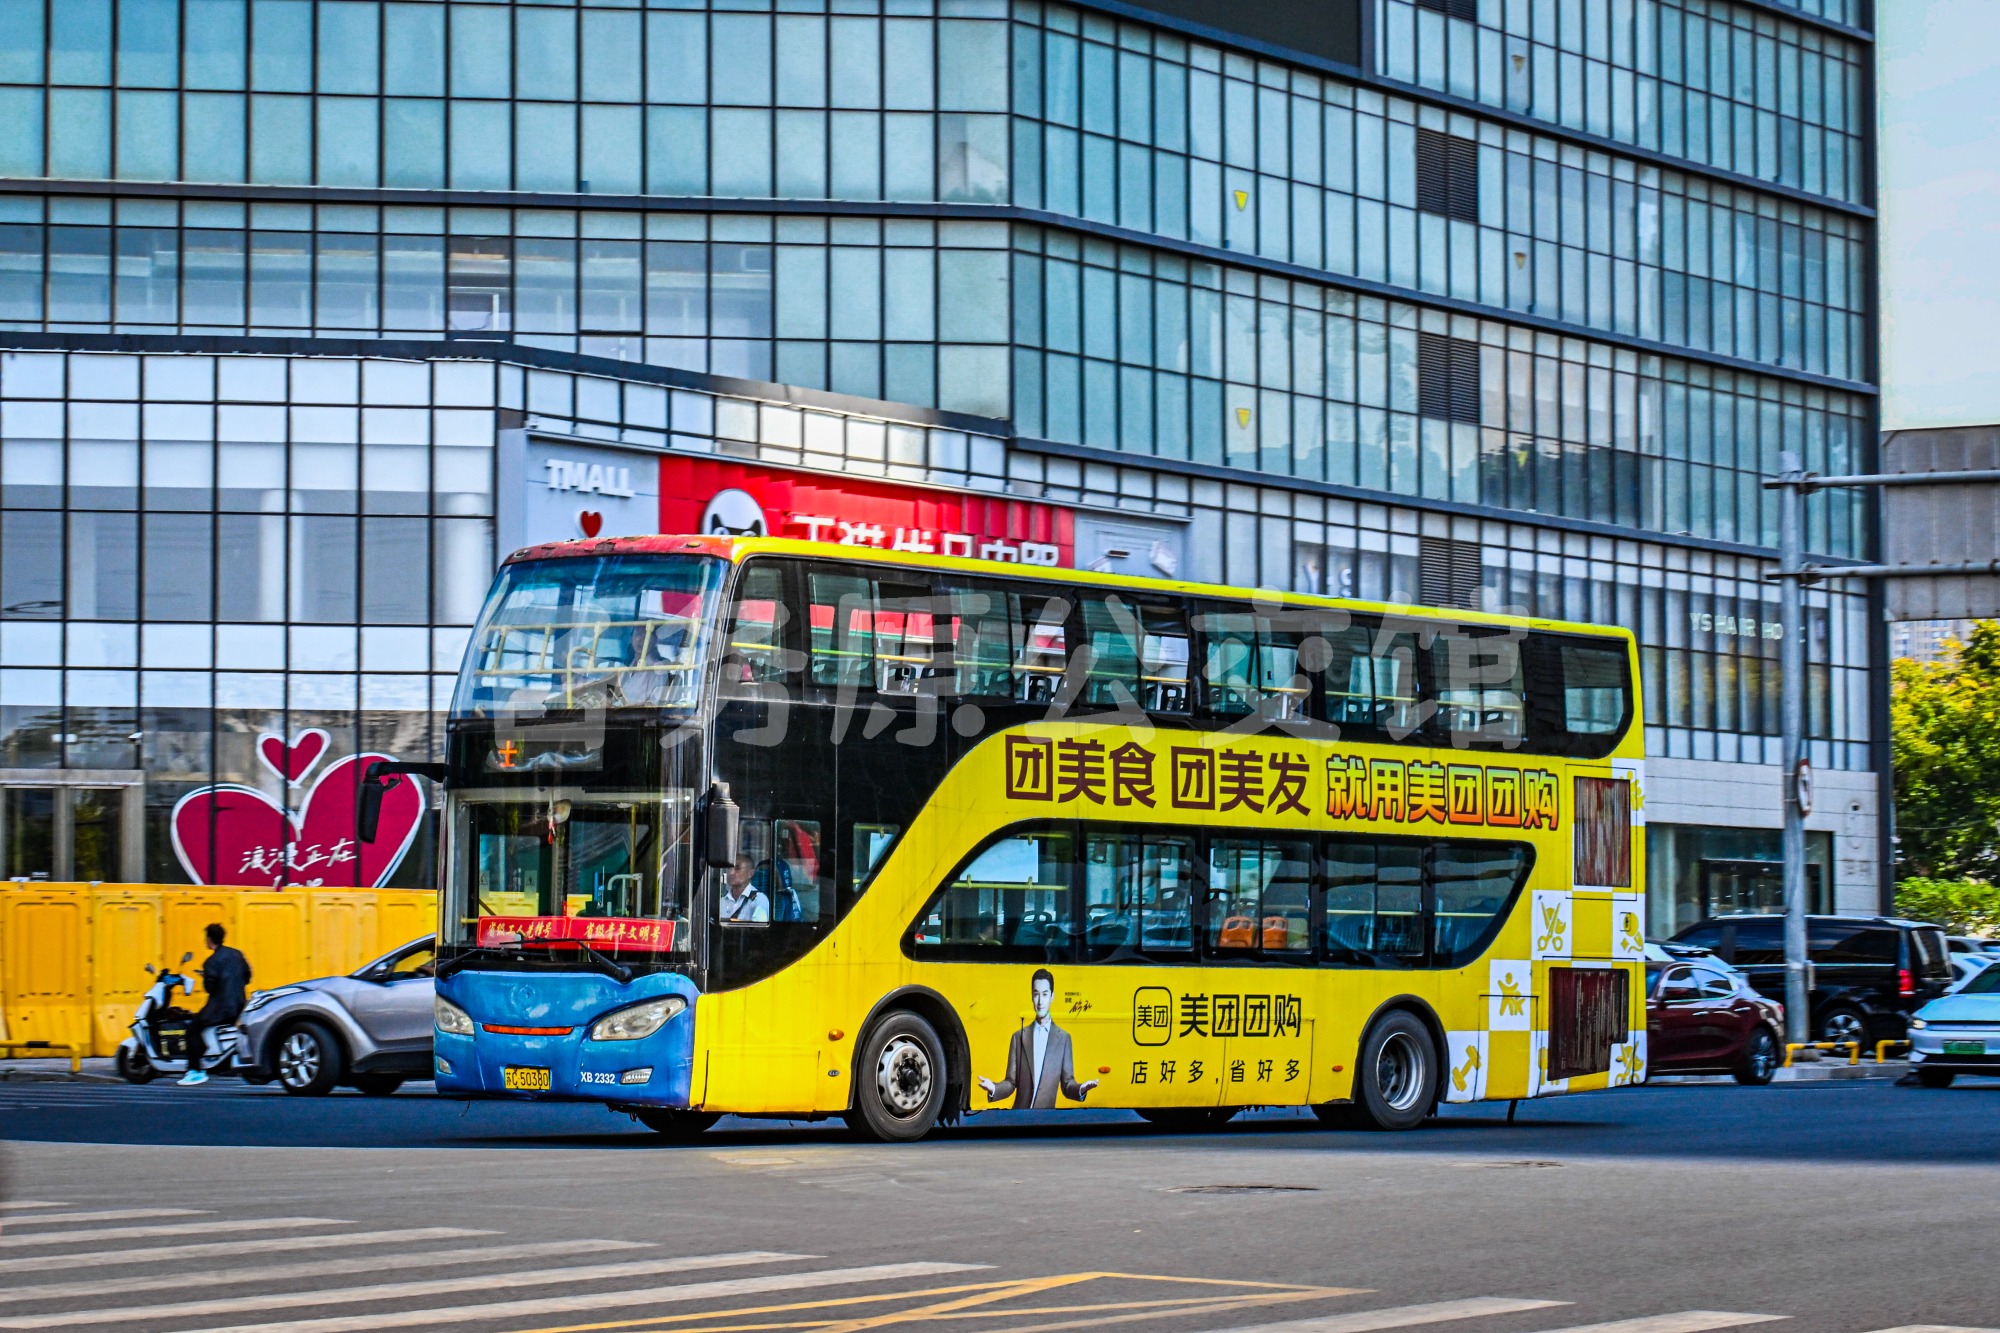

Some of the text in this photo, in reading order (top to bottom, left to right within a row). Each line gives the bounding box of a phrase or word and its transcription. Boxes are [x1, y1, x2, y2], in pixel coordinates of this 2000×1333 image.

[545, 459, 634, 497] TMALL
[1006, 735, 1560, 831] 团美食 团美发 就用美团团购
[238, 838, 356, 875] 浪漫正在
[585, 922, 661, 943] 省级青年文明号
[1137, 1004, 1168, 1028] 美团
[1179, 993, 1302, 1038] 美团团购
[580, 1071, 615, 1084] XB 2332
